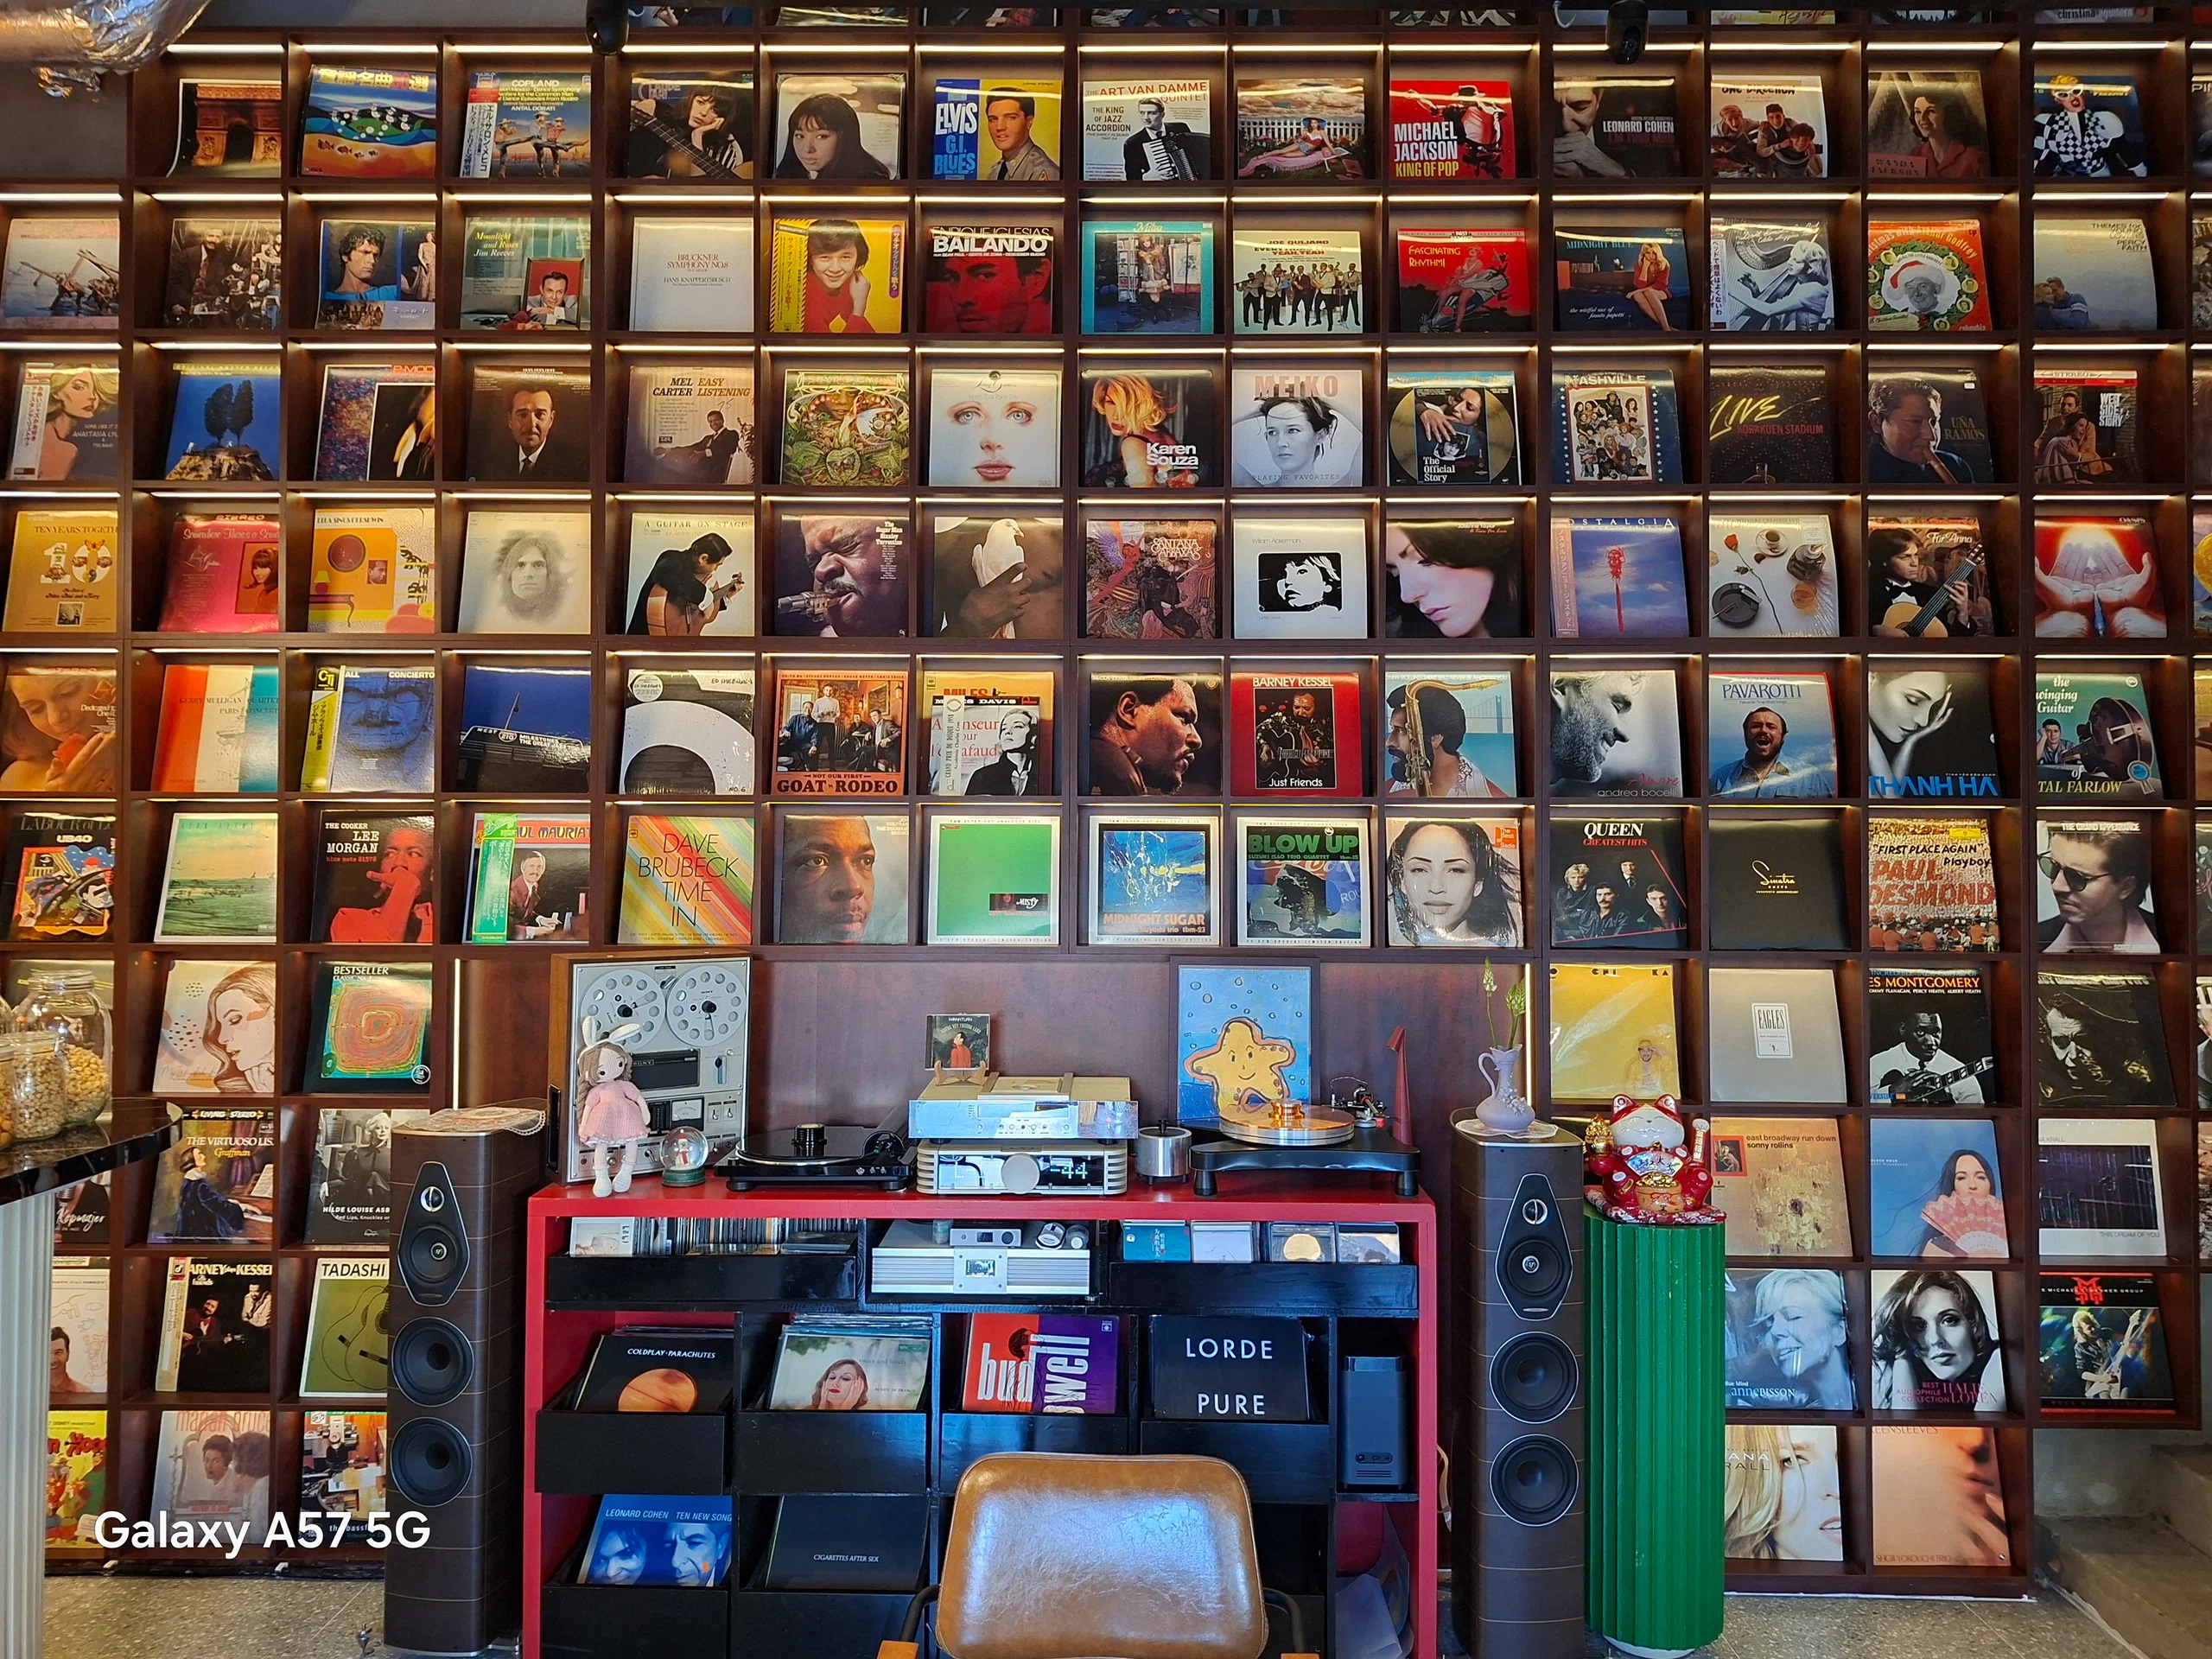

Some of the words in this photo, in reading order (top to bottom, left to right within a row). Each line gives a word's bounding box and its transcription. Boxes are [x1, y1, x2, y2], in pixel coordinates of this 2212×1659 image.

[1100, 86, 1125, 96] ART
[1128, 85, 1154, 94] VAN
[1159, 81, 1207, 93] DAMME
[936, 103, 978, 135] ELVIS
[1086, 124, 1131, 132] ACCORDION
[1394, 122, 1458, 142] MICHAEL
[1603, 121, 1642, 133] LEONARD
[1644, 121, 1675, 133] COHEN
[946, 135, 968, 154] G.I.
[1394, 142, 1458, 162] JACKSON
[934, 153, 976, 175] BLUES
[1395, 162, 1421, 177] KING
[1423, 162, 1435, 177] OF
[1437, 161, 1459, 176] POP
[475, 232, 512, 241] Moonlight
[1408, 245, 1460, 255] FASCINATING
[1566, 240, 1608, 249] MIDNIGHT
[1611, 240, 1633, 249] BLUE
[670, 378, 693, 386] MEL
[1568, 374, 1646, 385] NASHVILLE
[696, 387, 750, 397] LISTENING
[1254, 375, 1338, 397] MEIKO
[652, 388, 693, 397] CARTER
[2100, 394, 2122, 404] WEST
[2100, 405, 2120, 416] SIDE
[2099, 416, 2123, 427] STORY
[1738, 424, 1783, 434] KORAKUEN
[1786, 424, 1824, 434] STADIUM
[1942, 429, 1986, 441] RAMOS
[1146, 443, 1197, 454] Karen
[1146, 454, 1198, 466] Souza
[1423, 465, 1455, 474] Official
[1423, 474, 1447, 483] Story
[1927, 531, 1945, 543] Für
[1946, 531, 1973, 543] Anna
[1151, 538, 1198, 550] SANTANA
[1253, 677, 1295, 687] BARNEY
[1298, 677, 1334, 687] KESSEL
[2053, 675, 2069, 688] the
[1722, 683, 1802, 699] PAVAROTTI
[2037, 701, 2074, 714] Guitar
[2071, 767, 2083, 779] of
[777, 780, 827, 793] GOAT
[835, 780, 898, 794] RODEO
[1268, 778, 1286, 787] Just
[1289, 778, 1323, 787] Friends
[2038, 780, 2063, 793] TAL
[2067, 781, 2122, 793] FARLOW
[1598, 788, 1638, 798] andrea
[1642, 787, 1677, 798] bocelli
[353, 830, 380, 842] LEE
[1584, 823, 1644, 841] QUEEN
[56, 835, 92, 843] UB40
[663, 834, 719, 854] DAVE
[1248, 834, 1321, 854] BLOW
[1325, 834, 1358, 854] UP
[1583, 838, 1626, 847] GREATEST
[326, 842, 378, 854] MORGAN
[1873, 844, 1908, 854] "FIRST
[1909, 844, 1941, 854] PLACE
[1942, 843, 1984, 854] AGAIN"
[639, 857, 739, 877] BRUBECK
[1944, 857, 1991, 868] Playboy
[1751, 860, 1796, 885] Sinatra
[1872, 861, 1935, 880] PAUL
[663, 881, 713, 902] TIME
[1869, 882, 1996, 906] DESMOND
[1016, 897, 1039, 909] MISTY
[671, 906, 696, 927] IN
[1103, 913, 1161, 925] MIDNIGHT
[1164, 913, 1205, 925] SUGAR
[333, 966, 389, 975] BESTSELLER
[1885, 976, 1980, 988] MONTGOMERY
[1758, 1008, 1785, 1030] EAGLES
[200, 1110, 226, 1119] LIVING
[1764, 1134, 1801, 1142] broadway
[214, 1147, 251, 1158] Graffman
[321, 1263, 386, 1276] TADASHI
[627, 1348, 665, 1357] COLDPLAY
[668, 1350, 716, 1359] PARACHUTES
[1186, 1338, 1274, 1359] LORDE
[1198, 1393, 1265, 1415] PURE
[606, 1508, 640, 1518] LEONARD
[642, 1510, 669, 1519] COHEN
[712, 1513, 733, 1522] SONG
